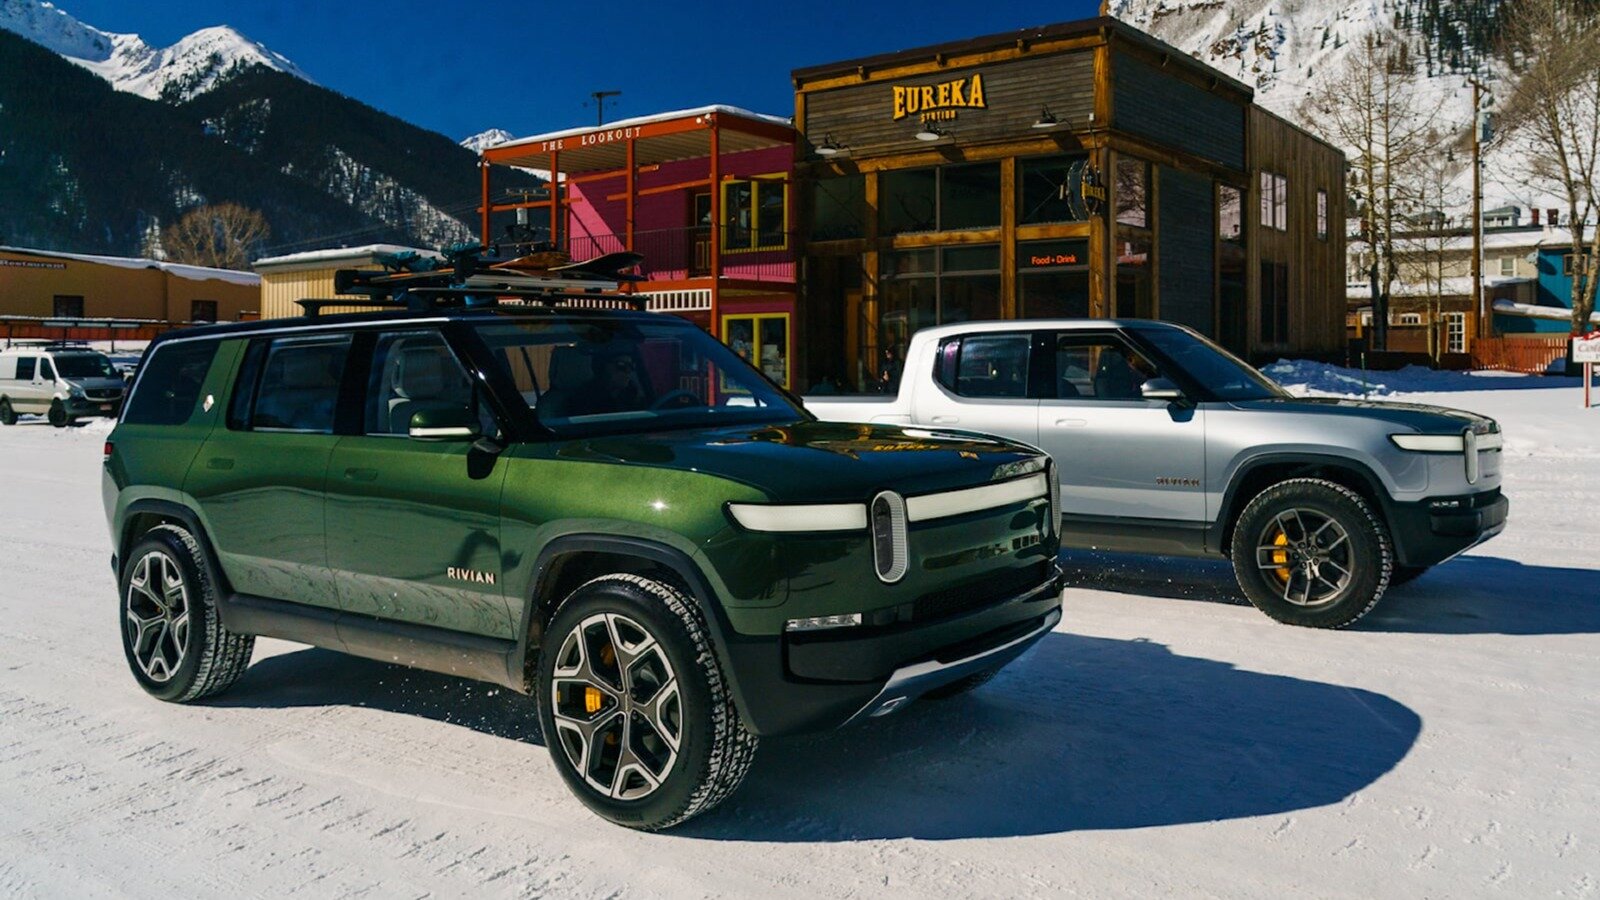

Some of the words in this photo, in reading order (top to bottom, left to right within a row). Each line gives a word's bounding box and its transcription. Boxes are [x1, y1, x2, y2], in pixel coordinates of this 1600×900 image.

[893, 74, 985, 120] EUREKA
[542, 140, 564, 152] THE
[581, 127, 641, 146] LOOKOUT
[1031, 256, 1050, 264] Food
[1056, 254, 1077, 264] Drink
[1156, 477, 1200, 486] RIVIAN
[447, 566, 495, 584] RIVIAN
